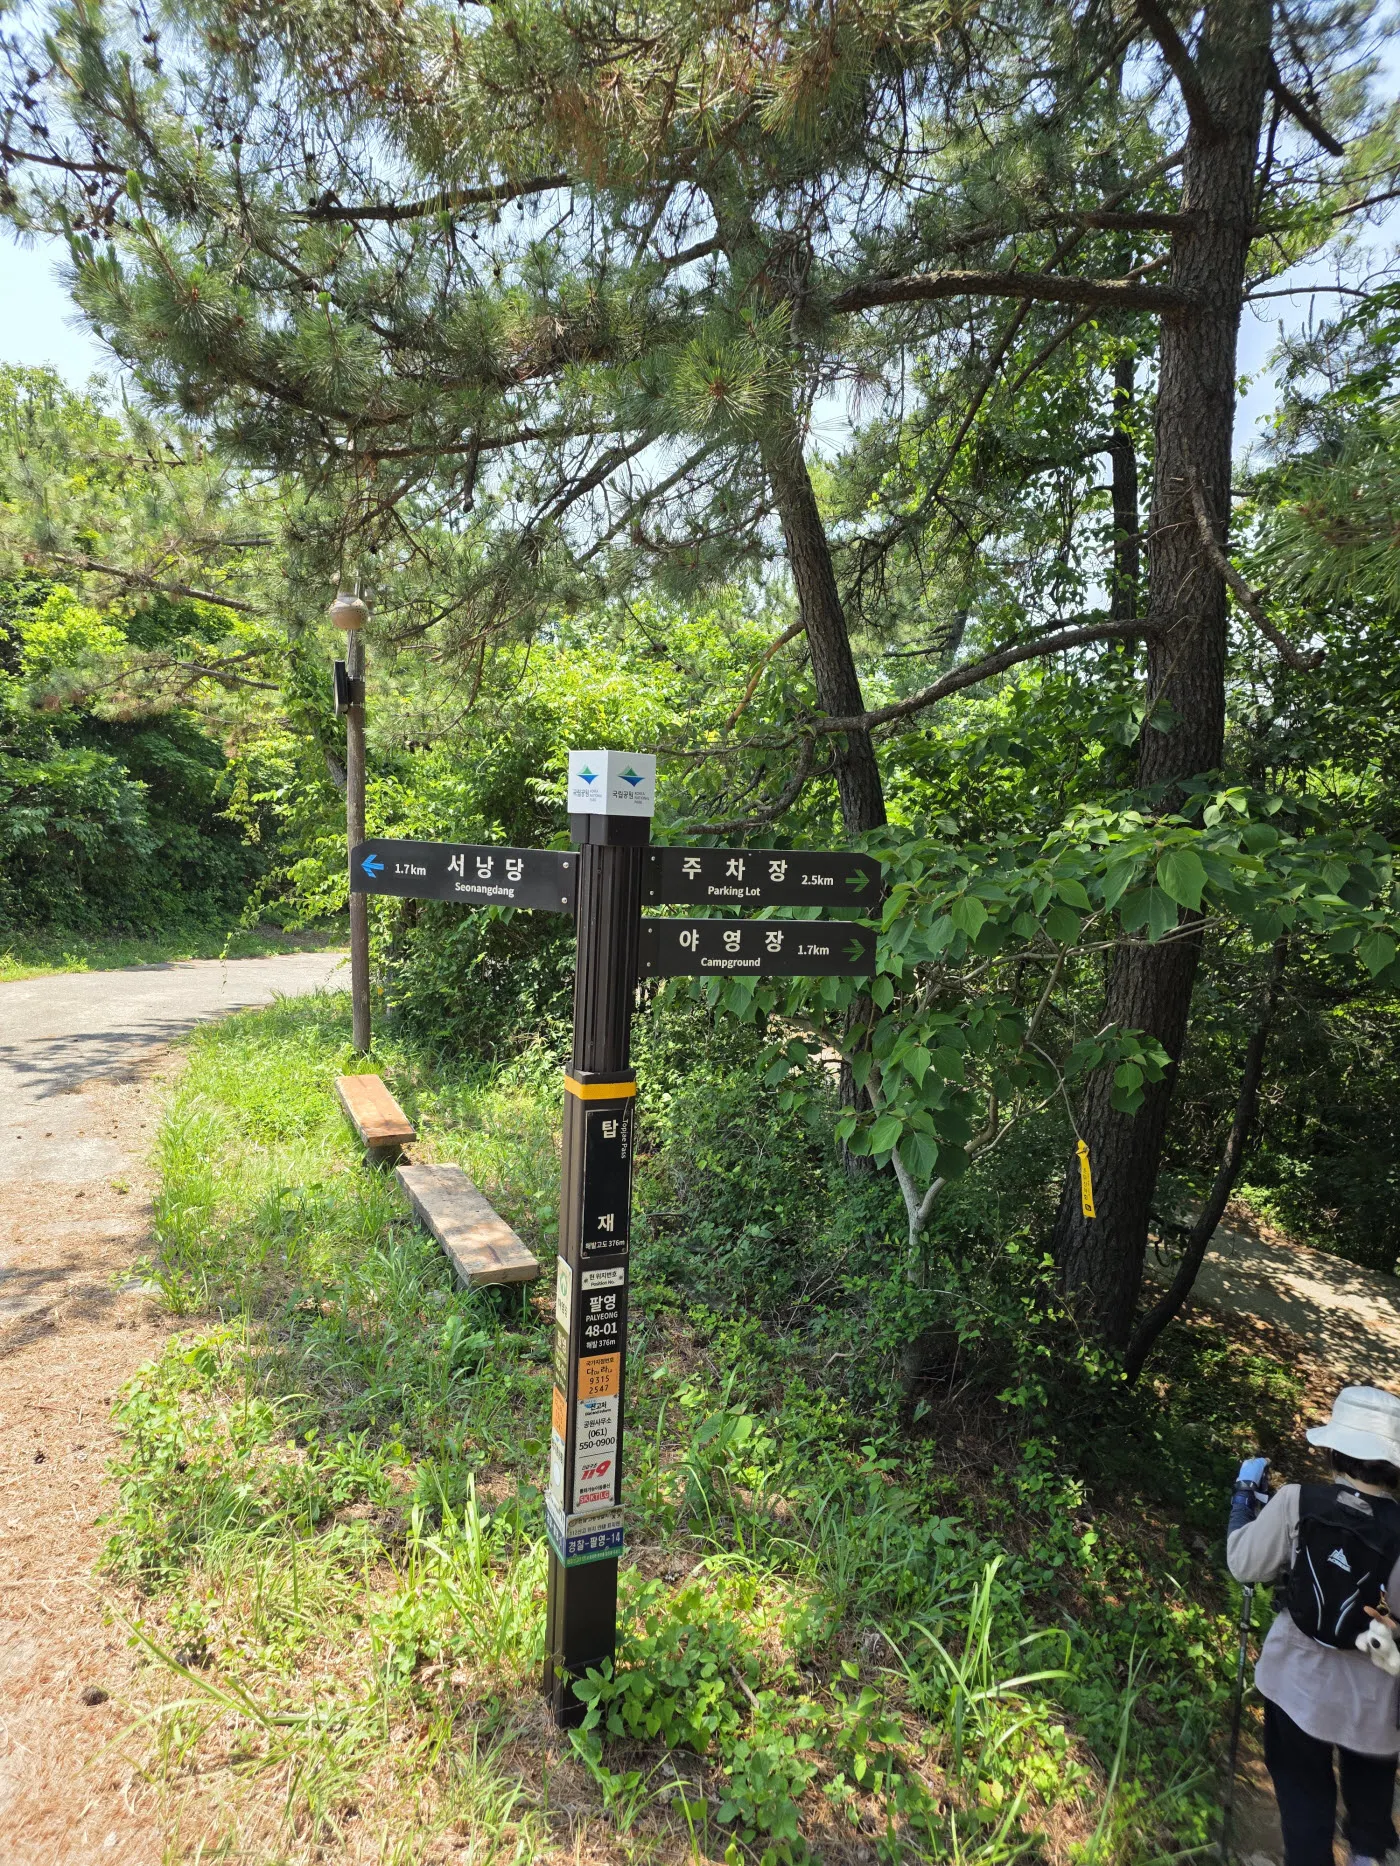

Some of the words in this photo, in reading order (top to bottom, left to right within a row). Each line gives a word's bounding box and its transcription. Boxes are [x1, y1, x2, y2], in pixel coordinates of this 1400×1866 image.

[612, 790, 634, 800] 국립공원
[394, 863, 427, 876] 1.7km
[801, 875, 834, 886] 2.5km
[454, 881, 515, 898] Seonangdang
[707, 886, 744, 898] Parking
[745, 886, 761, 897] Lot
[797, 945, 830, 956] 1.7km
[700, 957, 761, 969] Campground
[621, 1119, 629, 1143] Topjae
[620, 1143, 628, 1159] Pass
[589, 1294, 616, 1313] 팔영
[585, 1311, 618, 1322] PALYEONG
[585, 1322, 618, 1337] 48-01
[586, 1341, 599, 1349] 해발
[599, 1339, 616, 1347] 376m
[589, 1375, 610, 1385] 9315
[589, 1385, 609, 1395] 2547
[584, 1418, 612, 1429] 공원사무소
[588, 1428, 608, 1439] (061)
[578, 1437, 616, 1451] 550-0900
[580, 1460, 612, 1481] 119
